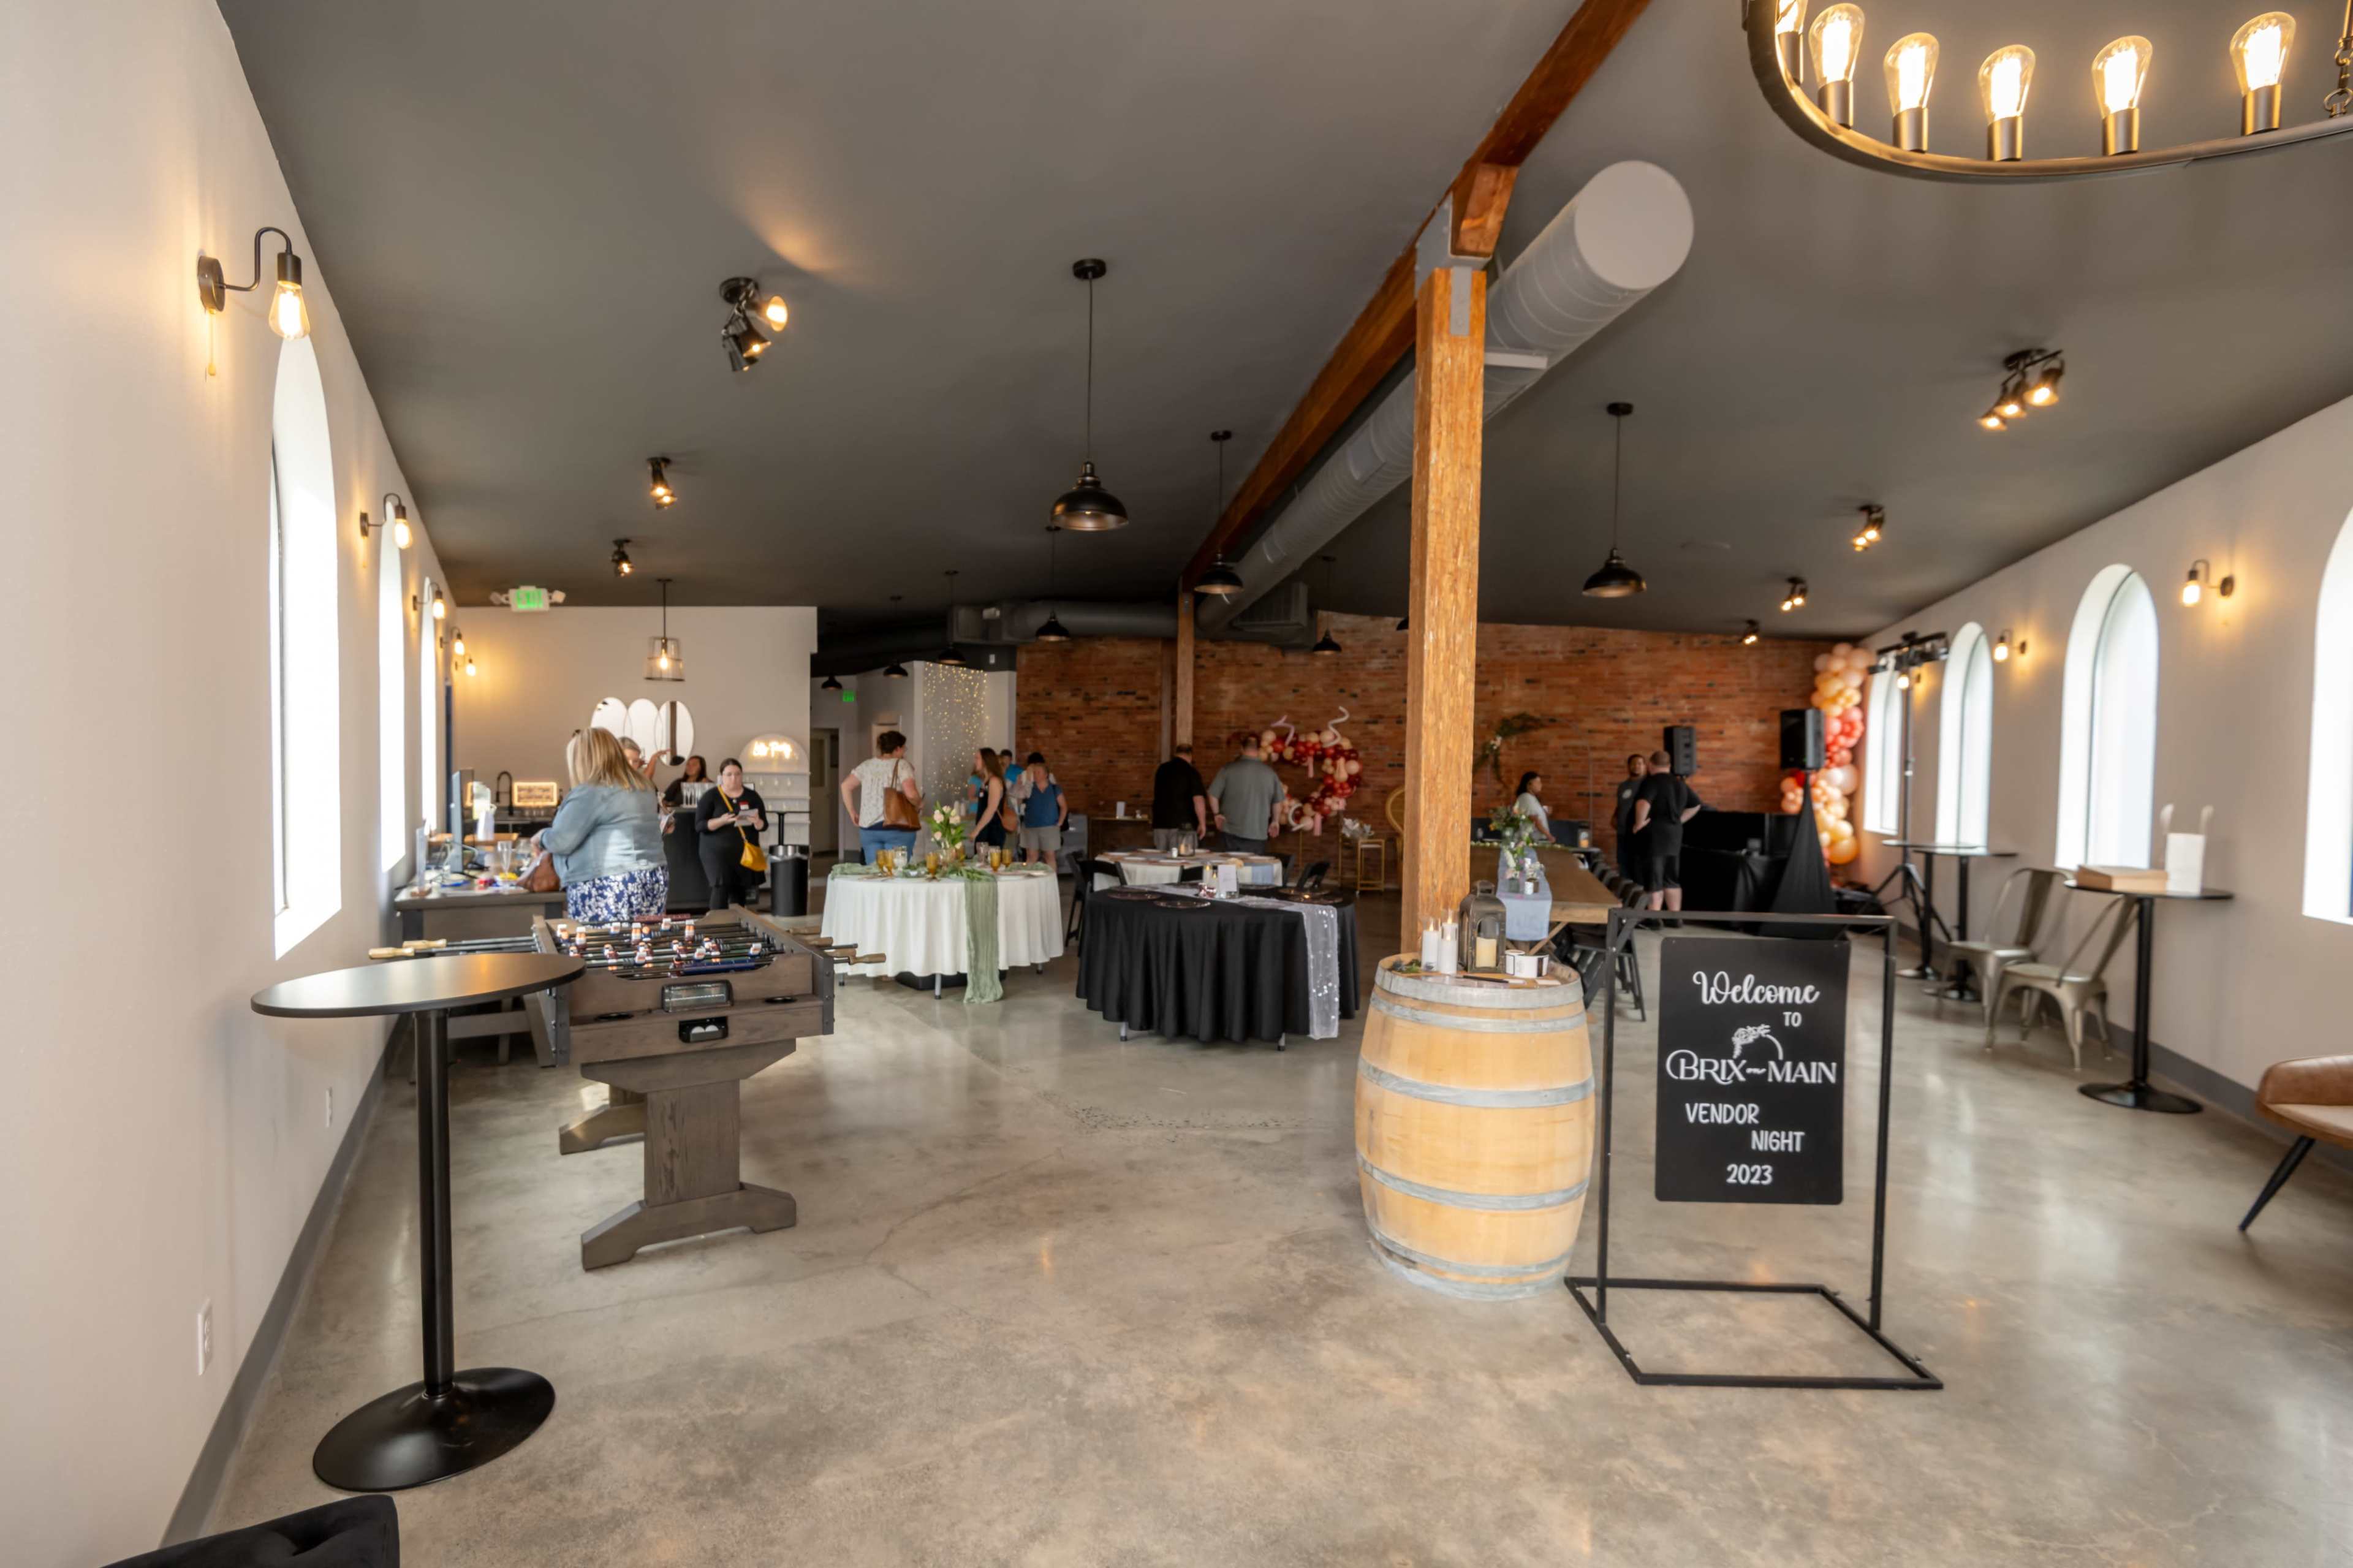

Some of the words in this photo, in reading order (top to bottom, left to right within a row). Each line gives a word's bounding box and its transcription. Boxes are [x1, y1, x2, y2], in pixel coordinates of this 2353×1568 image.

[1692, 971, 1820, 1005] Welcome
[1783, 1011, 1802, 1027] TO
[1665, 1049, 1746, 1085] BRIX
[1767, 1061, 1837, 1083] MAIN
[1685, 1102, 1760, 1125] VENDOR
[1751, 1130, 1805, 1152] NIGHT
[1726, 1164, 1773, 1185] 2023
